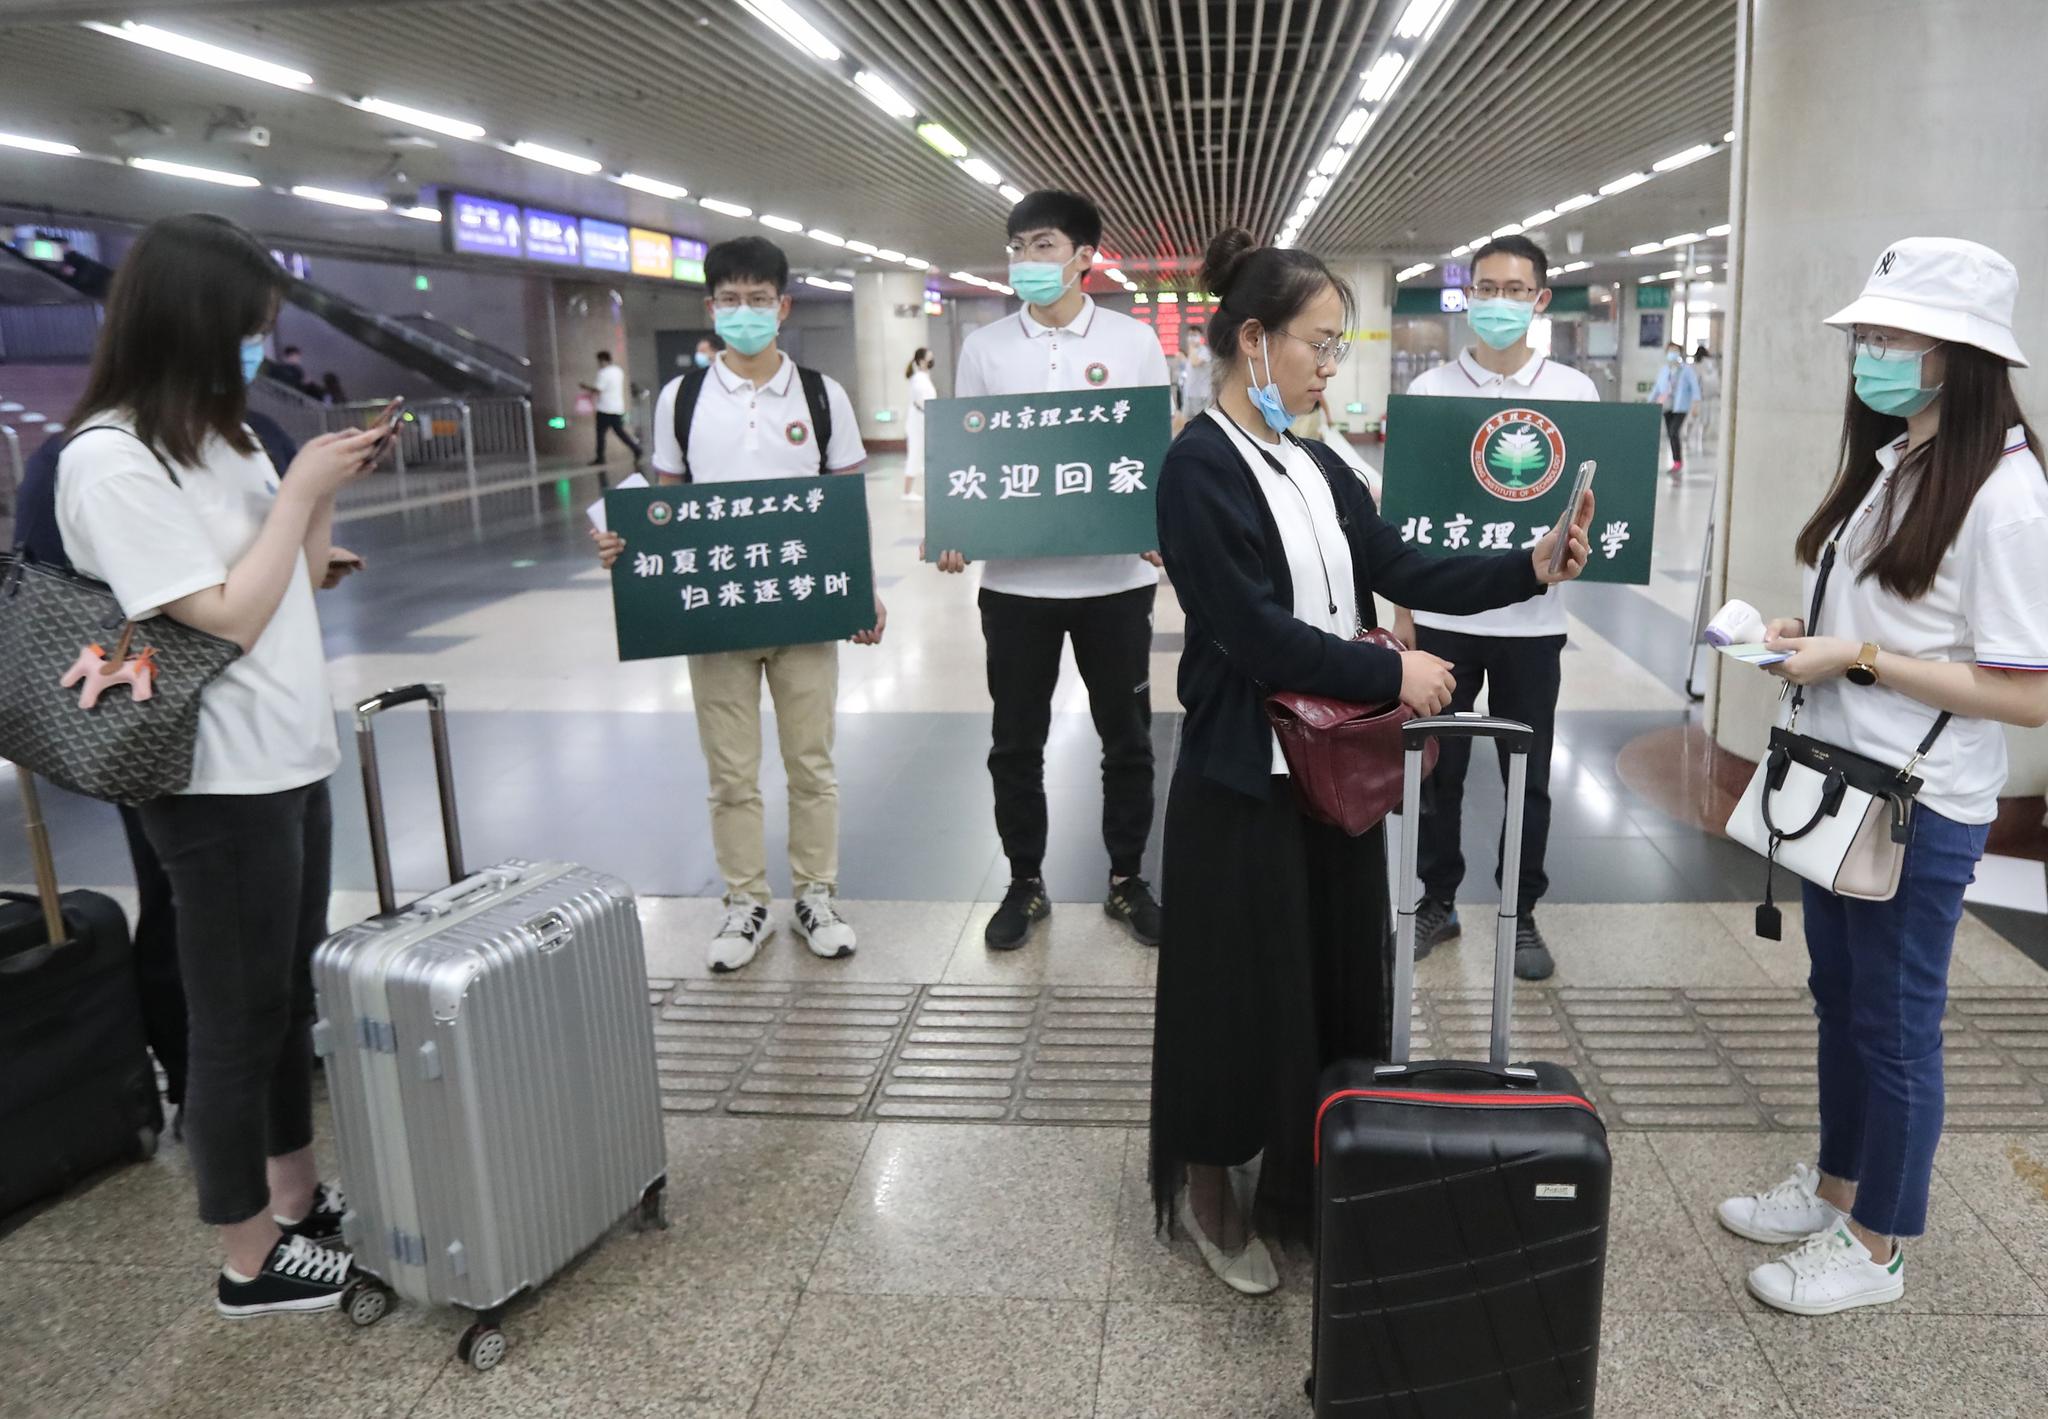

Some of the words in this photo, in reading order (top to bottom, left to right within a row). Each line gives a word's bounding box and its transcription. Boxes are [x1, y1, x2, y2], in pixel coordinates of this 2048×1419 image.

[948, 456, 1148, 500] 欢迎回家
[1484, 479, 1517, 498] INSTITUTE
[1519, 490, 1529, 498] OF
[1532, 454, 1561, 493] TECHNOLOGY
[633, 540, 808, 577] 初夏花开季
[681, 572, 851, 610] 归来逐梦时
